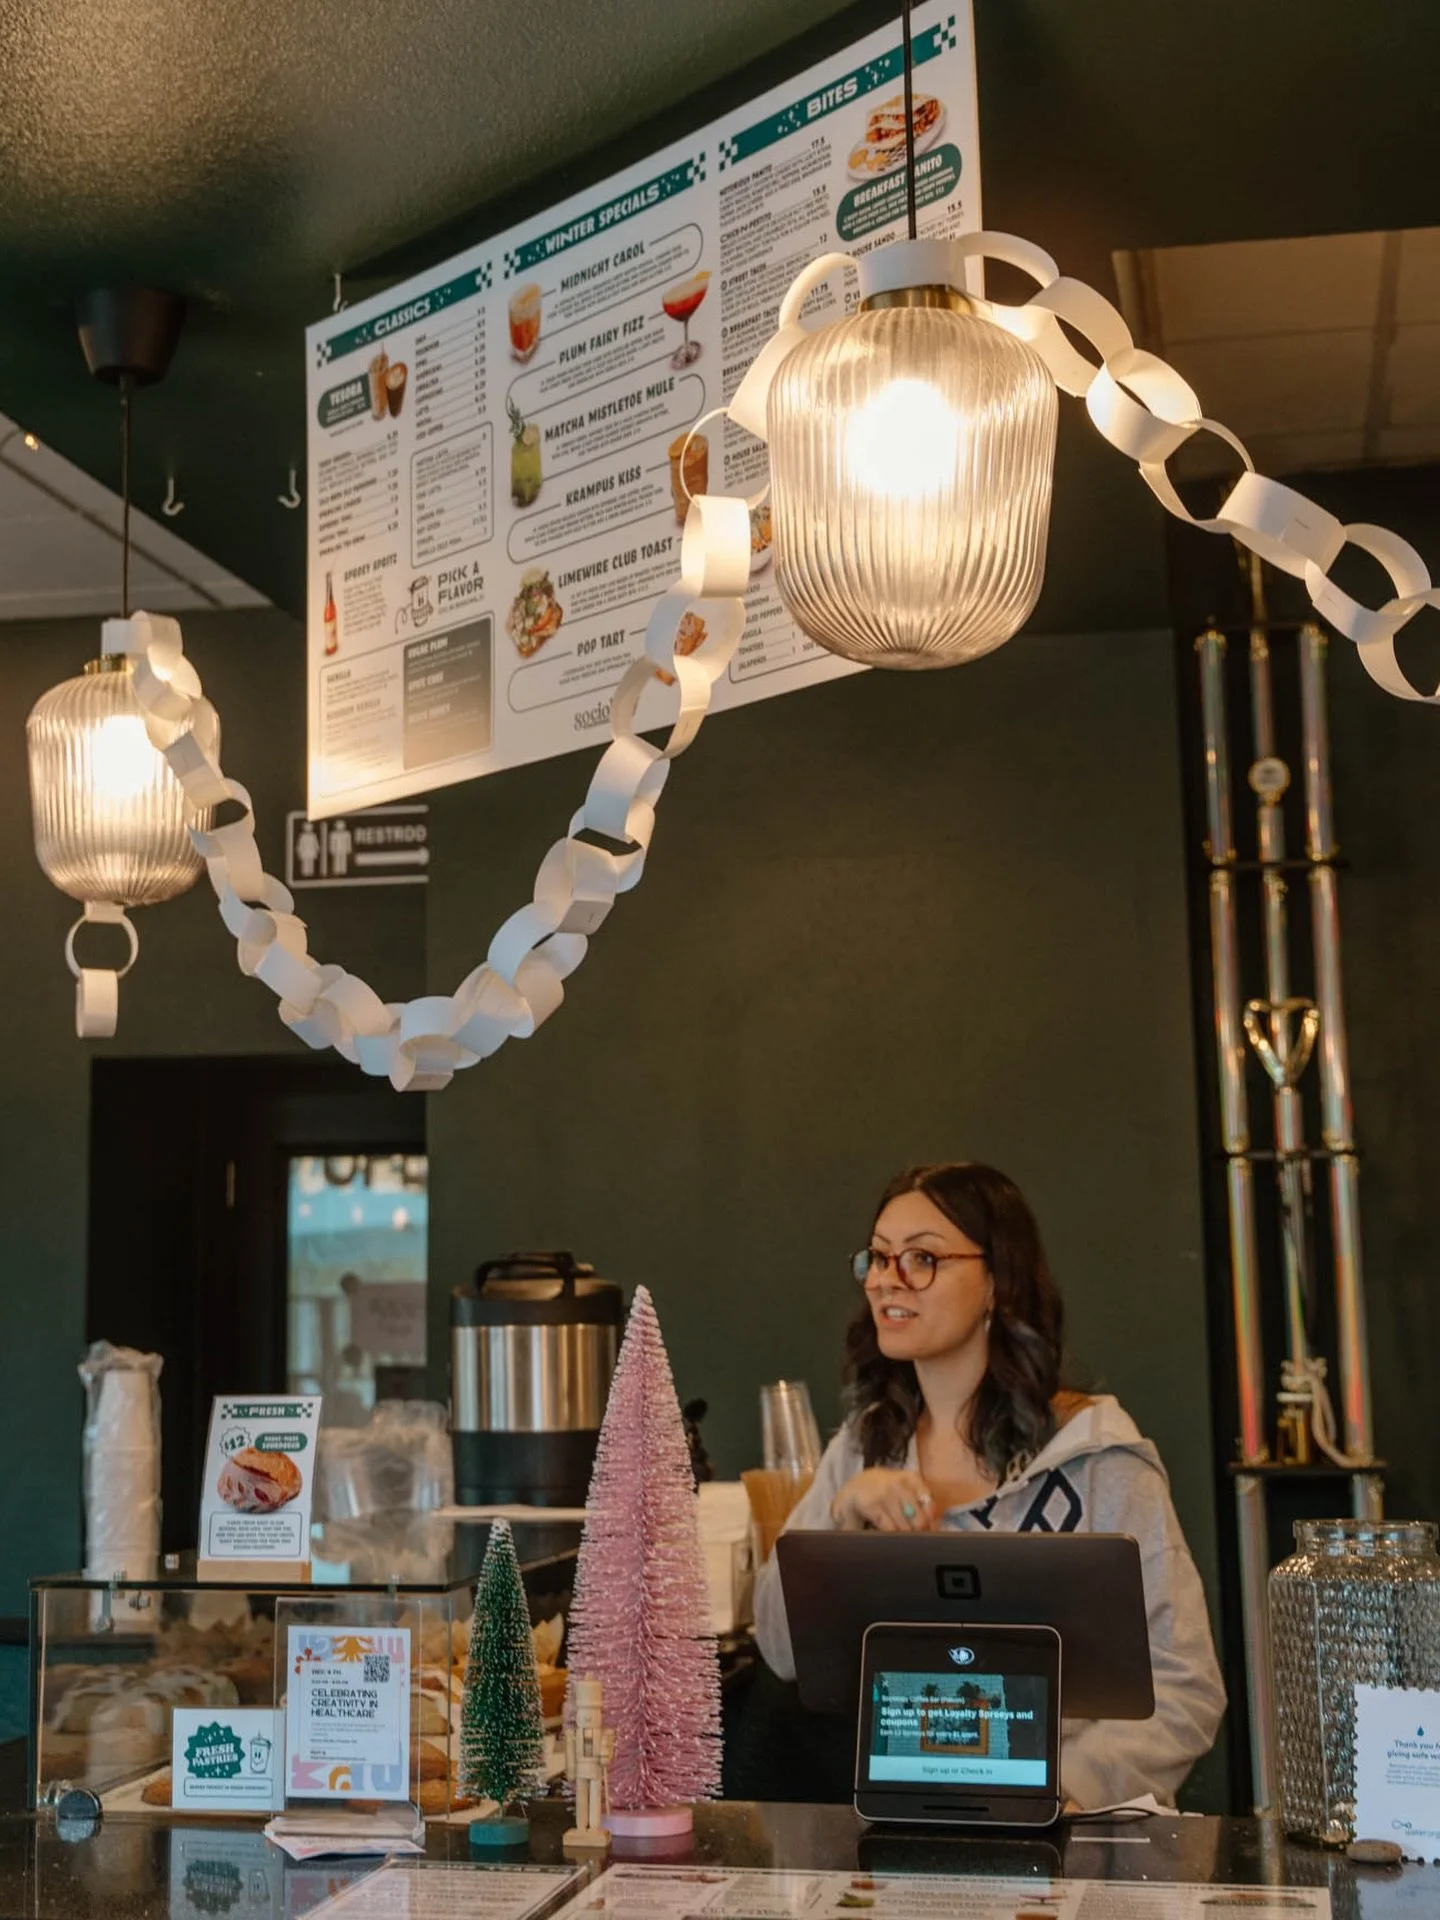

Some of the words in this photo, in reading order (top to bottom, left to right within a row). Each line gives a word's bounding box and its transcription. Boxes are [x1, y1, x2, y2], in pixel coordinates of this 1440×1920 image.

[807, 77, 858, 119] BITES
[853, 171, 906, 208] BREAKFAST
[914, 154, 943, 177] ANITO
[545, 216, 596, 255] WINTER
[599, 183, 661, 227] SPECIALS
[560, 257, 610, 292] MIDNIGHT
[613, 241, 646, 269] CAROL
[728, 271, 749, 287] STREET
[374, 298, 431, 336] CLASSICS
[559, 341, 587, 365] PLUM
[590, 326, 620, 352] FAIRY
[622, 315, 645, 337] FIZZ
[544, 415, 585, 442] MATCHA
[588, 389, 643, 425] MISTLETOE
[646, 377, 675, 401] MULE
[565, 475, 615, 507] KRAMPUS
[618, 465, 642, 486] KISS
[558, 558, 610, 589] LIMEWIRE
[612, 547, 638, 570] CLUB
[640, 536, 674, 560] TOAST
[437, 564, 468, 588] PICK
[473, 560, 480, 576] A
[437, 576, 485, 605] FLAVOR
[577, 637, 598, 657] POP
[600, 628, 625, 650] TART
[249, 1406, 286, 1417] FRESH
[311, 1688, 378, 1699] CELEBRATING
[311, 1698, 366, 1708] CREATIVITY
[369, 1699, 379, 1709] IN
[310, 1708, 375, 1718] HEALTHCARE
[880, 1718, 919, 1728] coupons
[881, 1706, 901, 1717] Sign
[903, 1708, 916, 1718] up
[916, 1708, 927, 1716] to
[927, 1708, 944, 1719] get
[944, 1708, 977, 1720] Loyalty
[1016, 1709, 1034, 1720] and
[195, 1742, 235, 1758] FRESH
[1387, 1749, 1410, 1759] giving
[1412, 1751, 1429, 1759] safe
[1394, 1740, 1419, 1749] Thank
[1419, 1742, 1434, 1751] you
[191, 1752, 239, 1768] PASTRIES
[922, 1766, 938, 1775] Sign
[940, 1767, 950, 1776] up
[960, 1766, 984, 1775] Check
[985, 1767, 993, 1775] in
